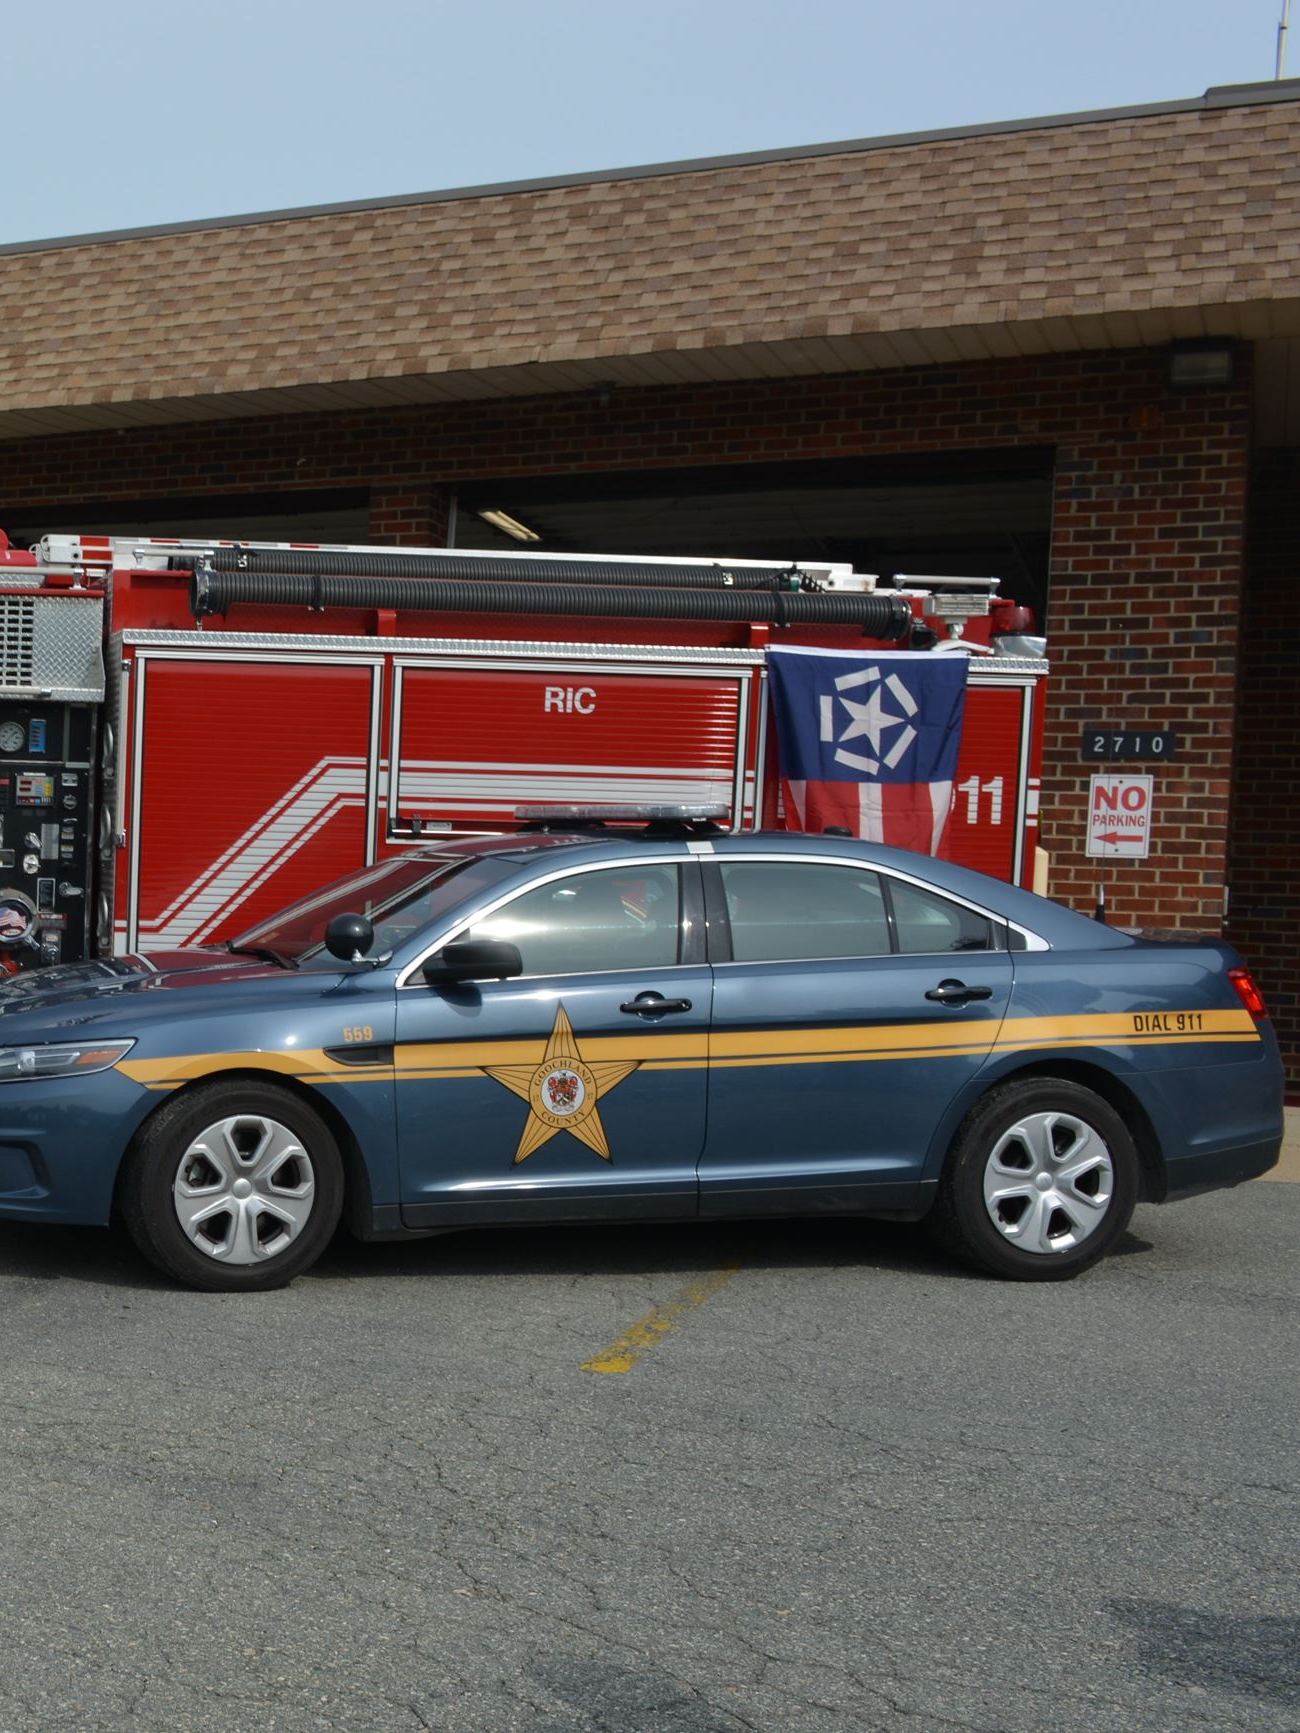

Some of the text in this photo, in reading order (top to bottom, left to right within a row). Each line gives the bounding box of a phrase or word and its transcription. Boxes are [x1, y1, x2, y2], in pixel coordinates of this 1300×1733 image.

[544, 686, 597, 715] RIC
[1092, 736, 1164, 753] 2710
[950, 775, 1004, 825] 11
[1093, 785, 1147, 812] NO
[1092, 813, 1146, 828] PARKING
[1133, 1014, 1202, 1032] DIAL 911
[534, 1060, 592, 1086] GOOCHLAND
[541, 1110, 585, 1126] COUNTY
